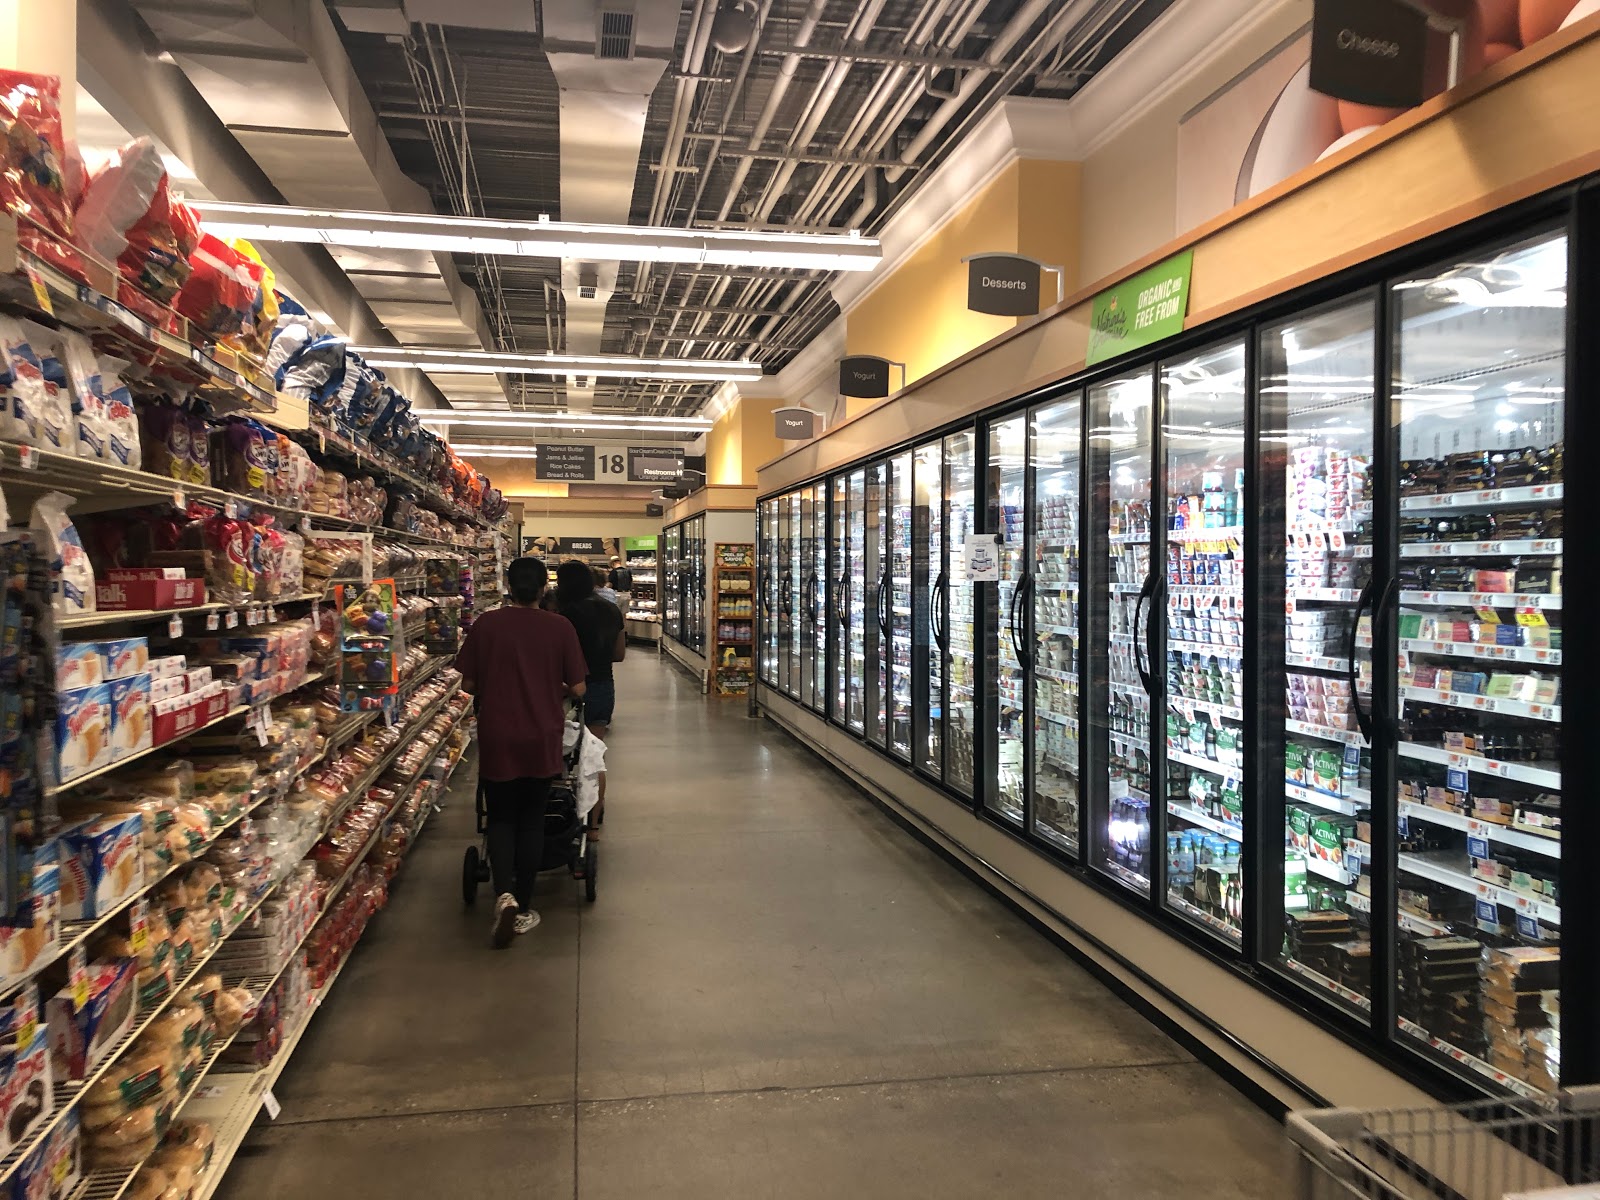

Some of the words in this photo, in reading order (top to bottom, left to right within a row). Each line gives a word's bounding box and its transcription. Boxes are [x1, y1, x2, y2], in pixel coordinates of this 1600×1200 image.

[1336, 28, 1400, 58] Cheese
[982, 276, 1027, 290] Desserts
[1137, 278, 1173, 310] ORGANIC
[1171, 276, 1183, 293] AND
[1134, 306, 1156, 331] FREE
[1155, 295, 1180, 322] FROM
[852, 371, 876, 381] Yogurt
[785, 419, 803, 427] Yogurt
[598, 454, 625, 474] 18
[643, 468, 676, 476] Restrooms
[1286, 751, 1303, 763] CTIVIA
[1314, 759, 1337, 772] ACTIVIA
[1315, 828, 1337, 842] ACTIVIA
